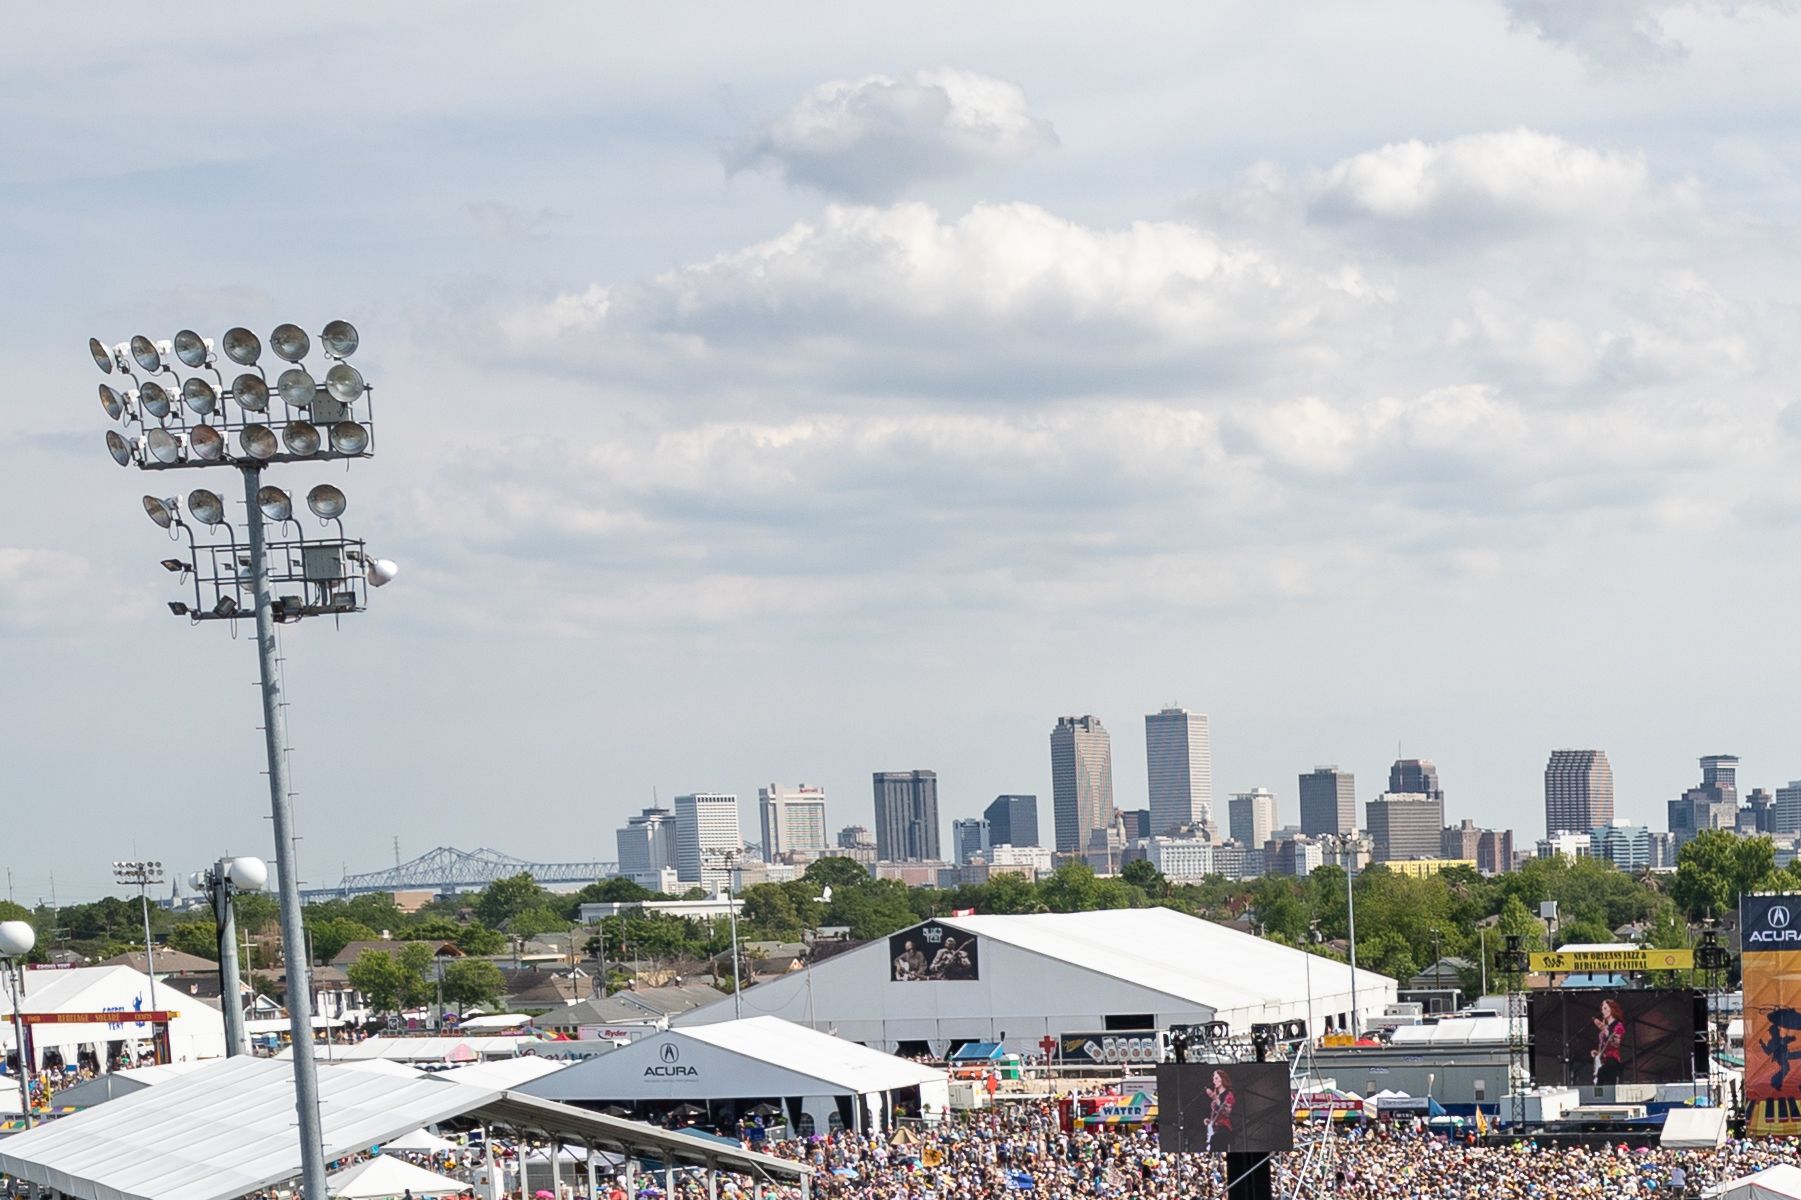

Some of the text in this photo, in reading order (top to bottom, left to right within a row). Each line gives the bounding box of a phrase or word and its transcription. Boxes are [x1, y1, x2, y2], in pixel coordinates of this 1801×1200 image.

[1573, 951, 1647, 961] NEW ORLEANS JAZZ &
[1574, 960, 1648, 970] HERITAGE FESTIVAL
[57, 1014, 89, 1022] HERITAGE
[95, 1013, 120, 1021] SQUARE
[605, 1029, 627, 1038] Ryder
[643, 1066, 699, 1077] ACURA
[1102, 1107, 1142, 1116] WATER
